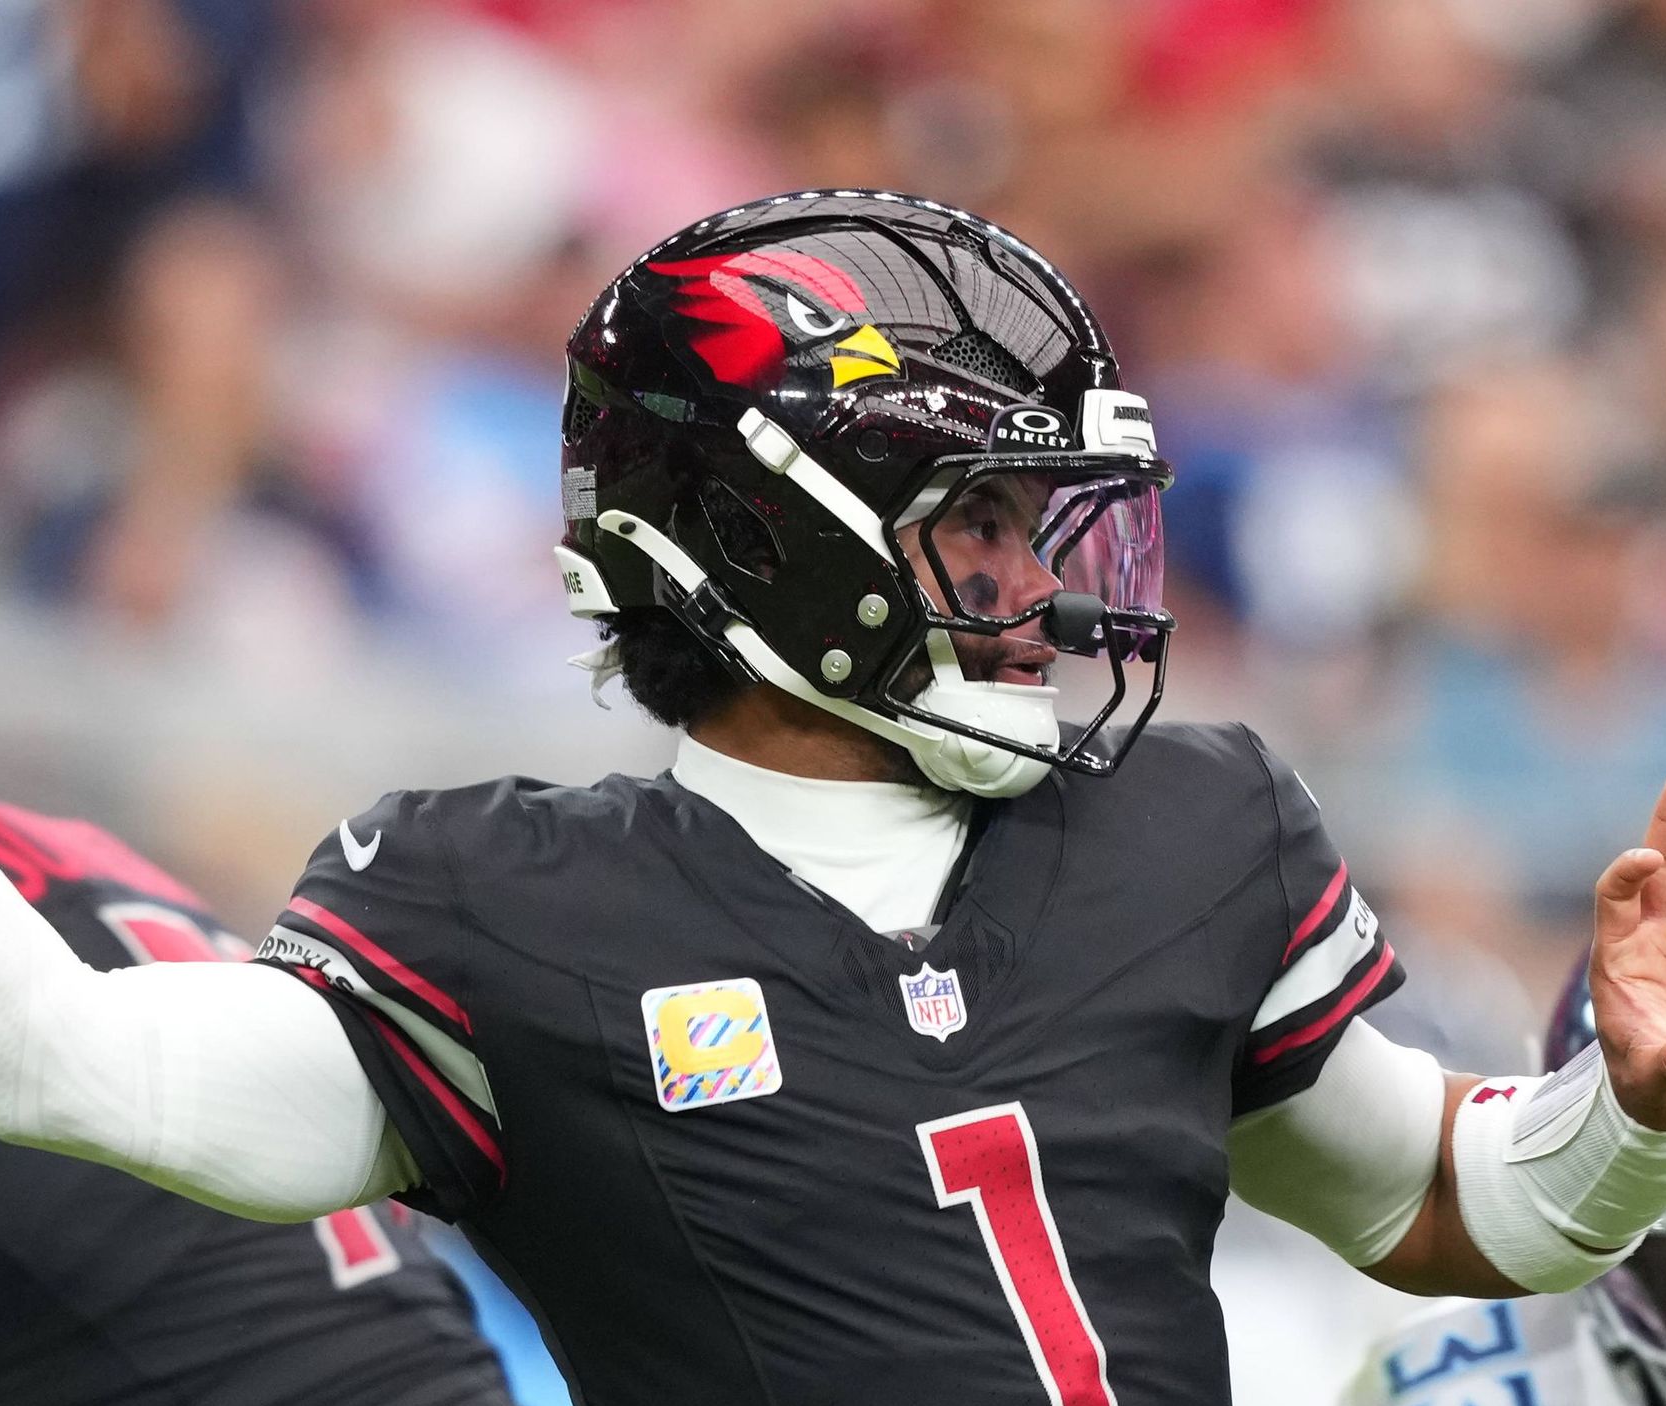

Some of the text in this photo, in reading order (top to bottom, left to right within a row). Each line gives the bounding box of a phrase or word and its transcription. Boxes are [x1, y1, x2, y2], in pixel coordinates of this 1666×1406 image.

[997, 428, 1070, 448] OAKLEY
[916, 998, 958, 1027] NFL
[657, 990, 765, 1075] C
